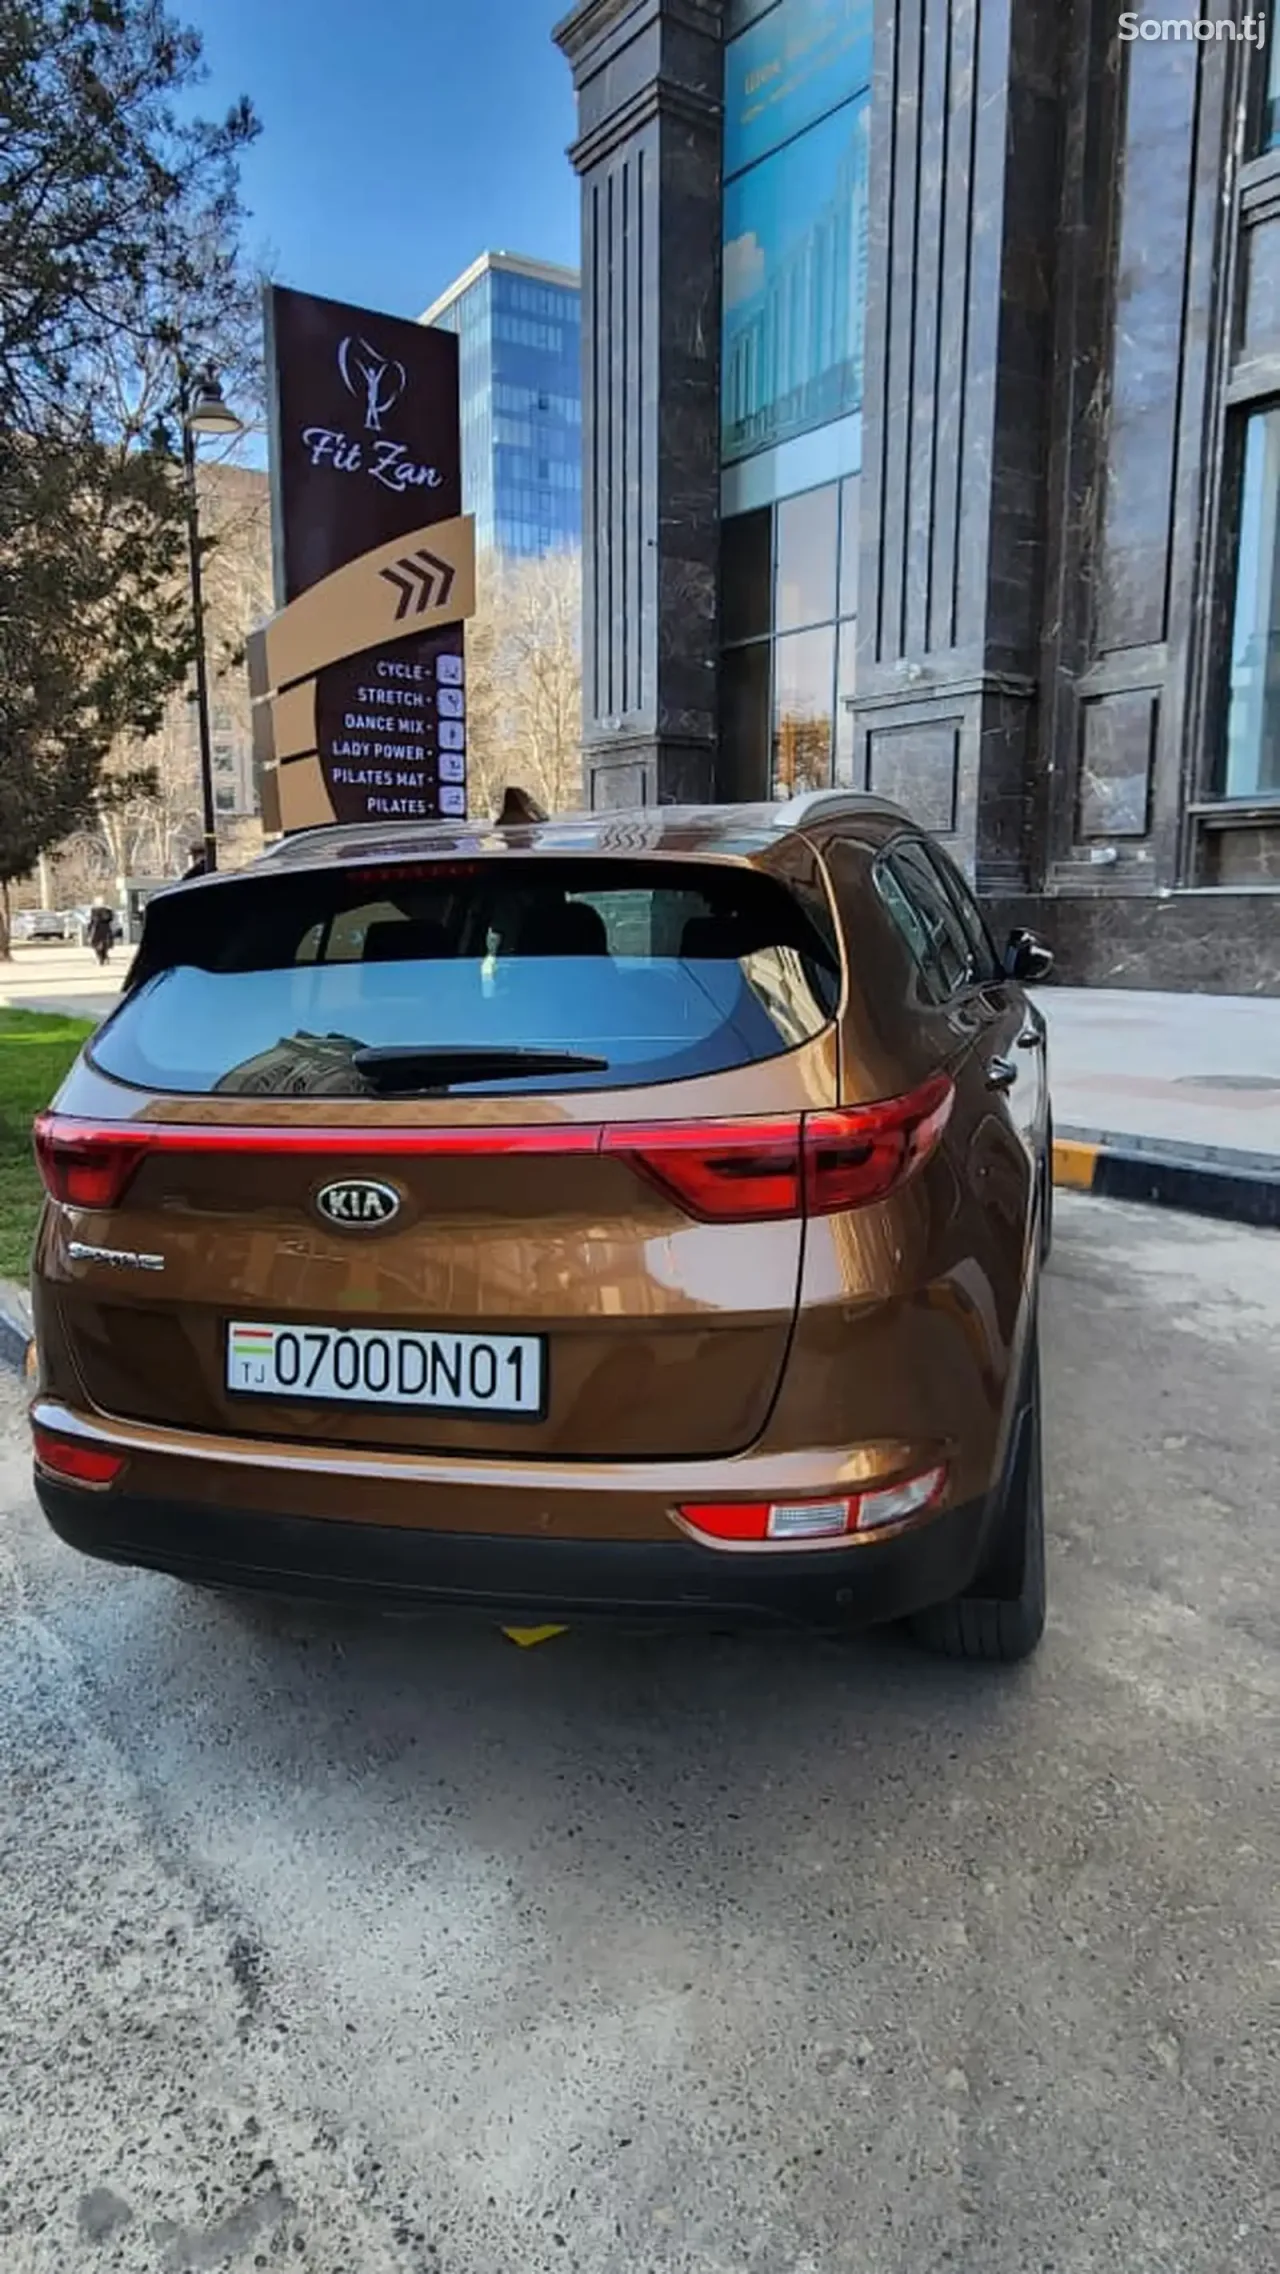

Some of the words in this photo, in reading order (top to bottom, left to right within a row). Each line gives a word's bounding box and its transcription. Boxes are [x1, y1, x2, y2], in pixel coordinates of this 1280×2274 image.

[302, 427, 362, 472] Fit
[368, 440, 443, 492] Zan
[376, 660, 423, 680] CYCLE
[357, 686, 424, 707] STRETCH
[344, 713, 395, 732] DANCE
[399, 718, 425, 734] MIX
[332, 741, 371, 757] LADY
[374, 743, 425, 760] POWER
[332, 767, 393, 786] PILATES
[396, 772, 425, 787] MAT
[367, 796, 426, 814] PILATES
[329, 1190, 385, 1217] KIA
[240, 1361, 266, 1384] TJ
[275, 1332, 523, 1402] 0700DN01
